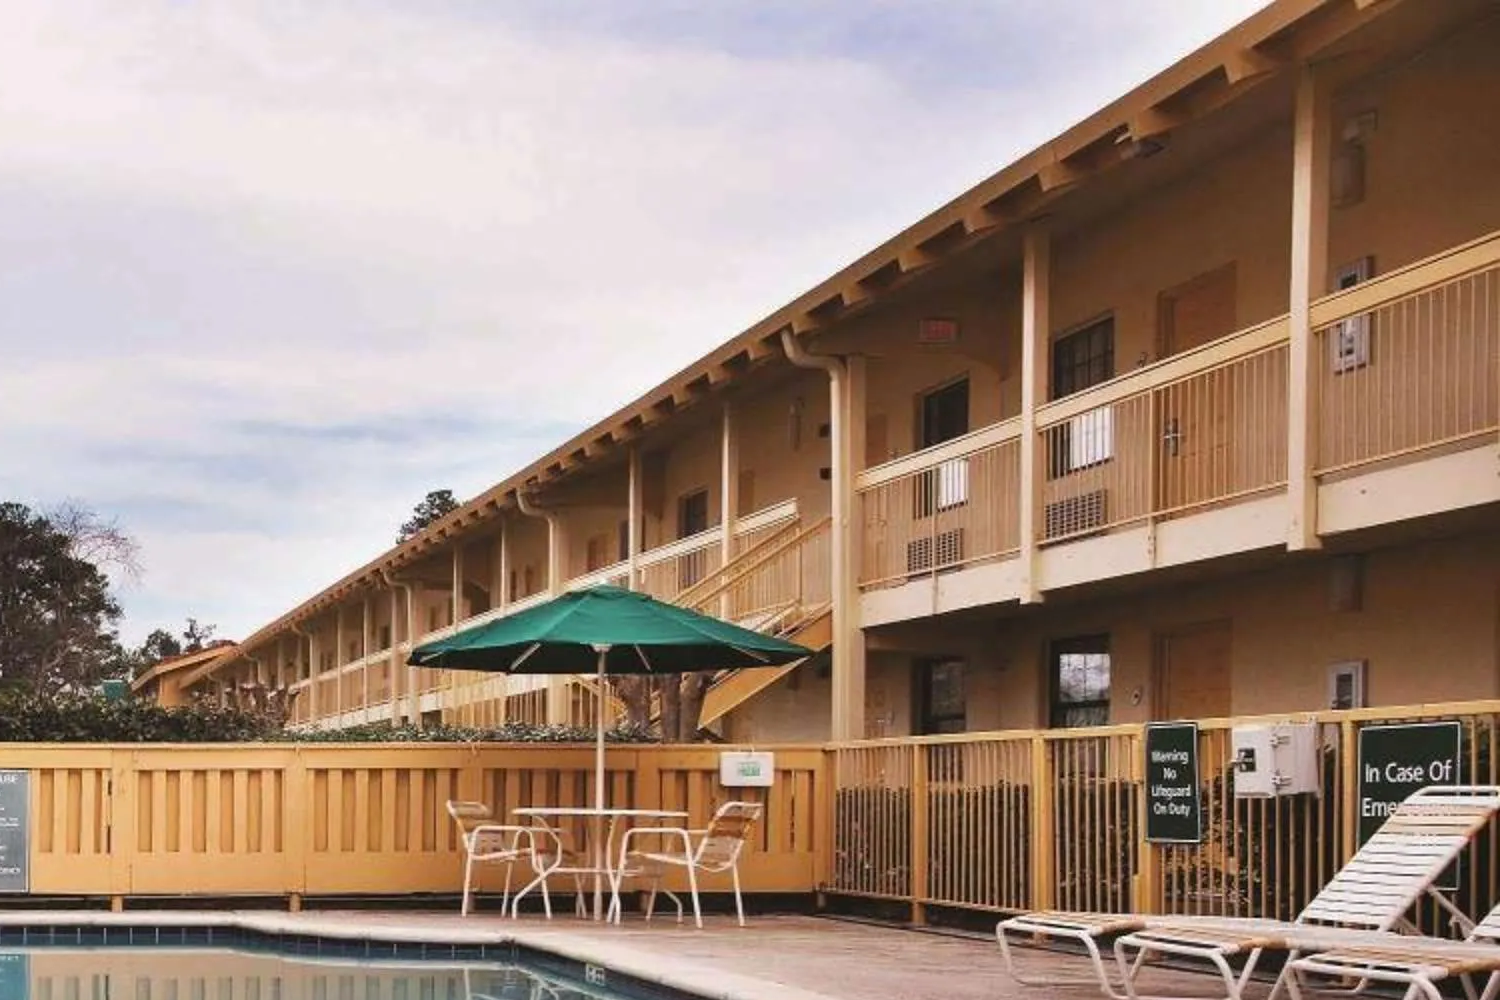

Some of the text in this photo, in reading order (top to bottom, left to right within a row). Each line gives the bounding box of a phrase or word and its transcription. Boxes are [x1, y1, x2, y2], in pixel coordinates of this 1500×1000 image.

[1151, 748, 1189, 765] Warning
[1163, 767, 1177, 780] No
[1365, 760, 1452, 783] In Case Of
[1151, 783, 1191, 800] Lifeguard
[1153, 802, 1191, 817] On Duty
